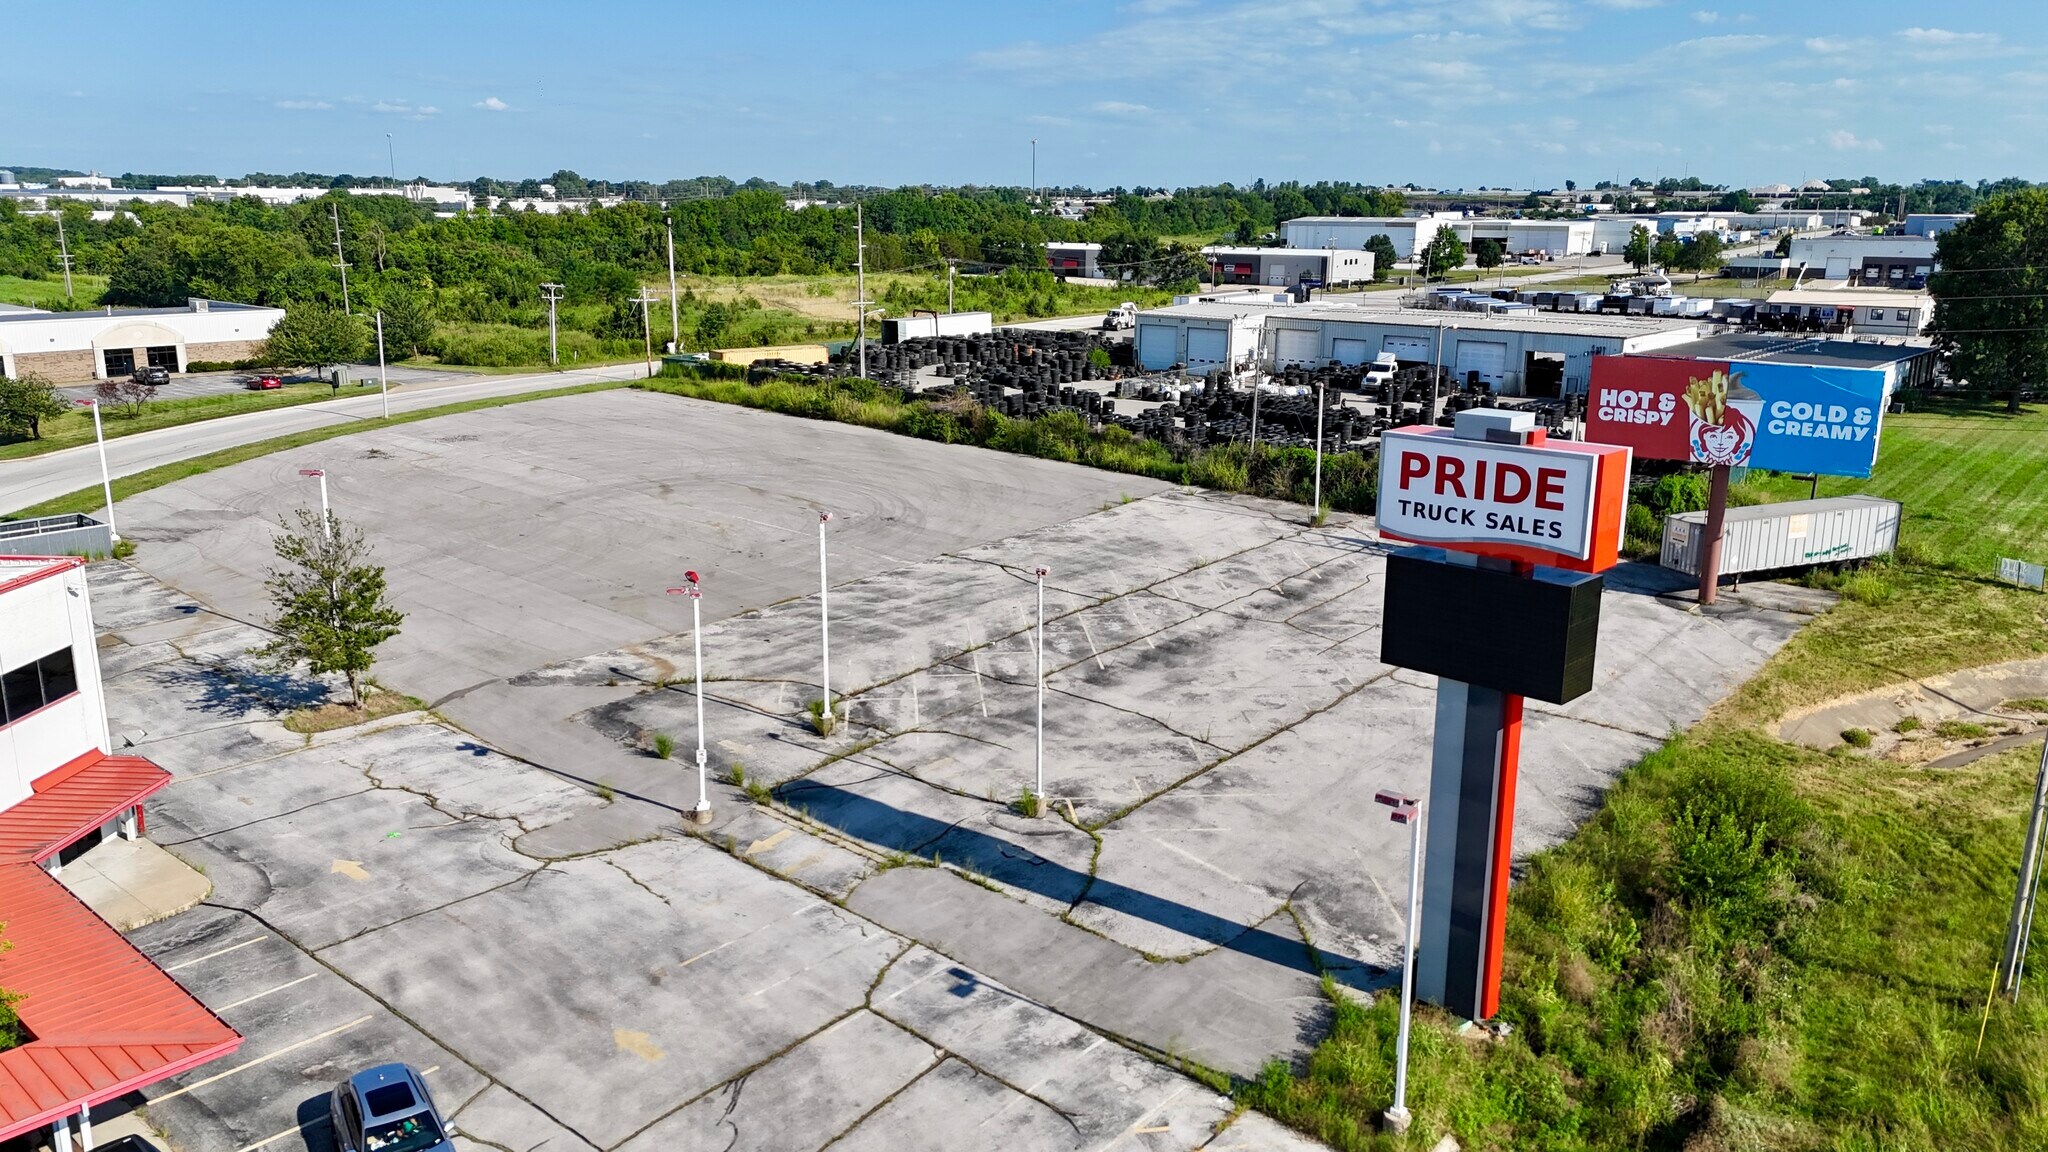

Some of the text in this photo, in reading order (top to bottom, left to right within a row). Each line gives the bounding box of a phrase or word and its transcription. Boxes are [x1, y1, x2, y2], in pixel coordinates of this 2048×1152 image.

[1600, 388, 1676, 411] HOT &
[1598, 407, 1674, 426] CRISPY
[1770, 400, 1872, 425] COLD &
[1768, 419, 1870, 441] CREAMY
[1399, 451, 1567, 511] PRIDE
[1398, 499, 1562, 539] TRUCK SALES
